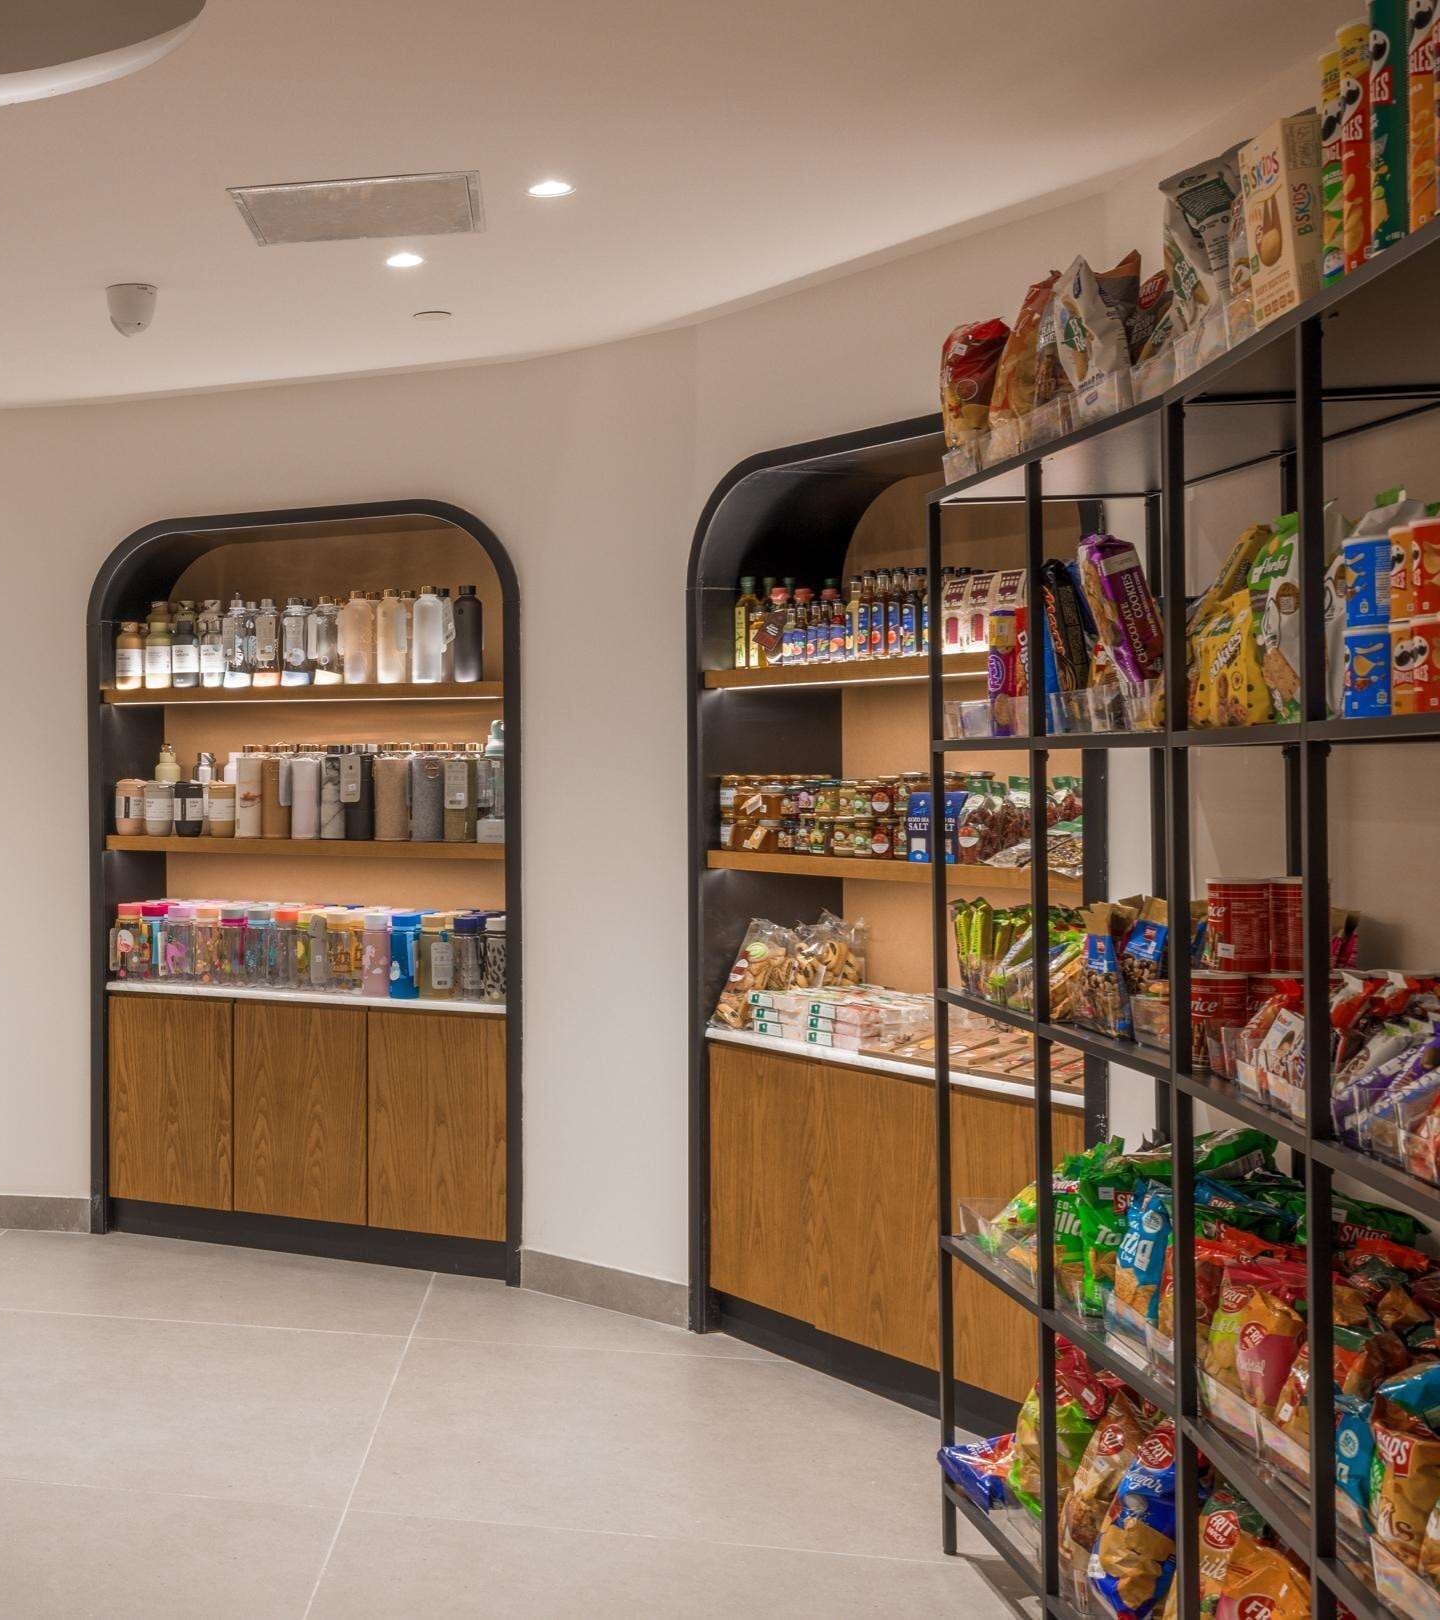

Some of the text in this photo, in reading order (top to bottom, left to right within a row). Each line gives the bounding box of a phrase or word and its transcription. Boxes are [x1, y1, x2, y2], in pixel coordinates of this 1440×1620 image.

[908, 822, 929, 831] SALT
[1144, 1437, 1173, 1463] FRIT
[1209, 1513, 1240, 1537] FRIT
